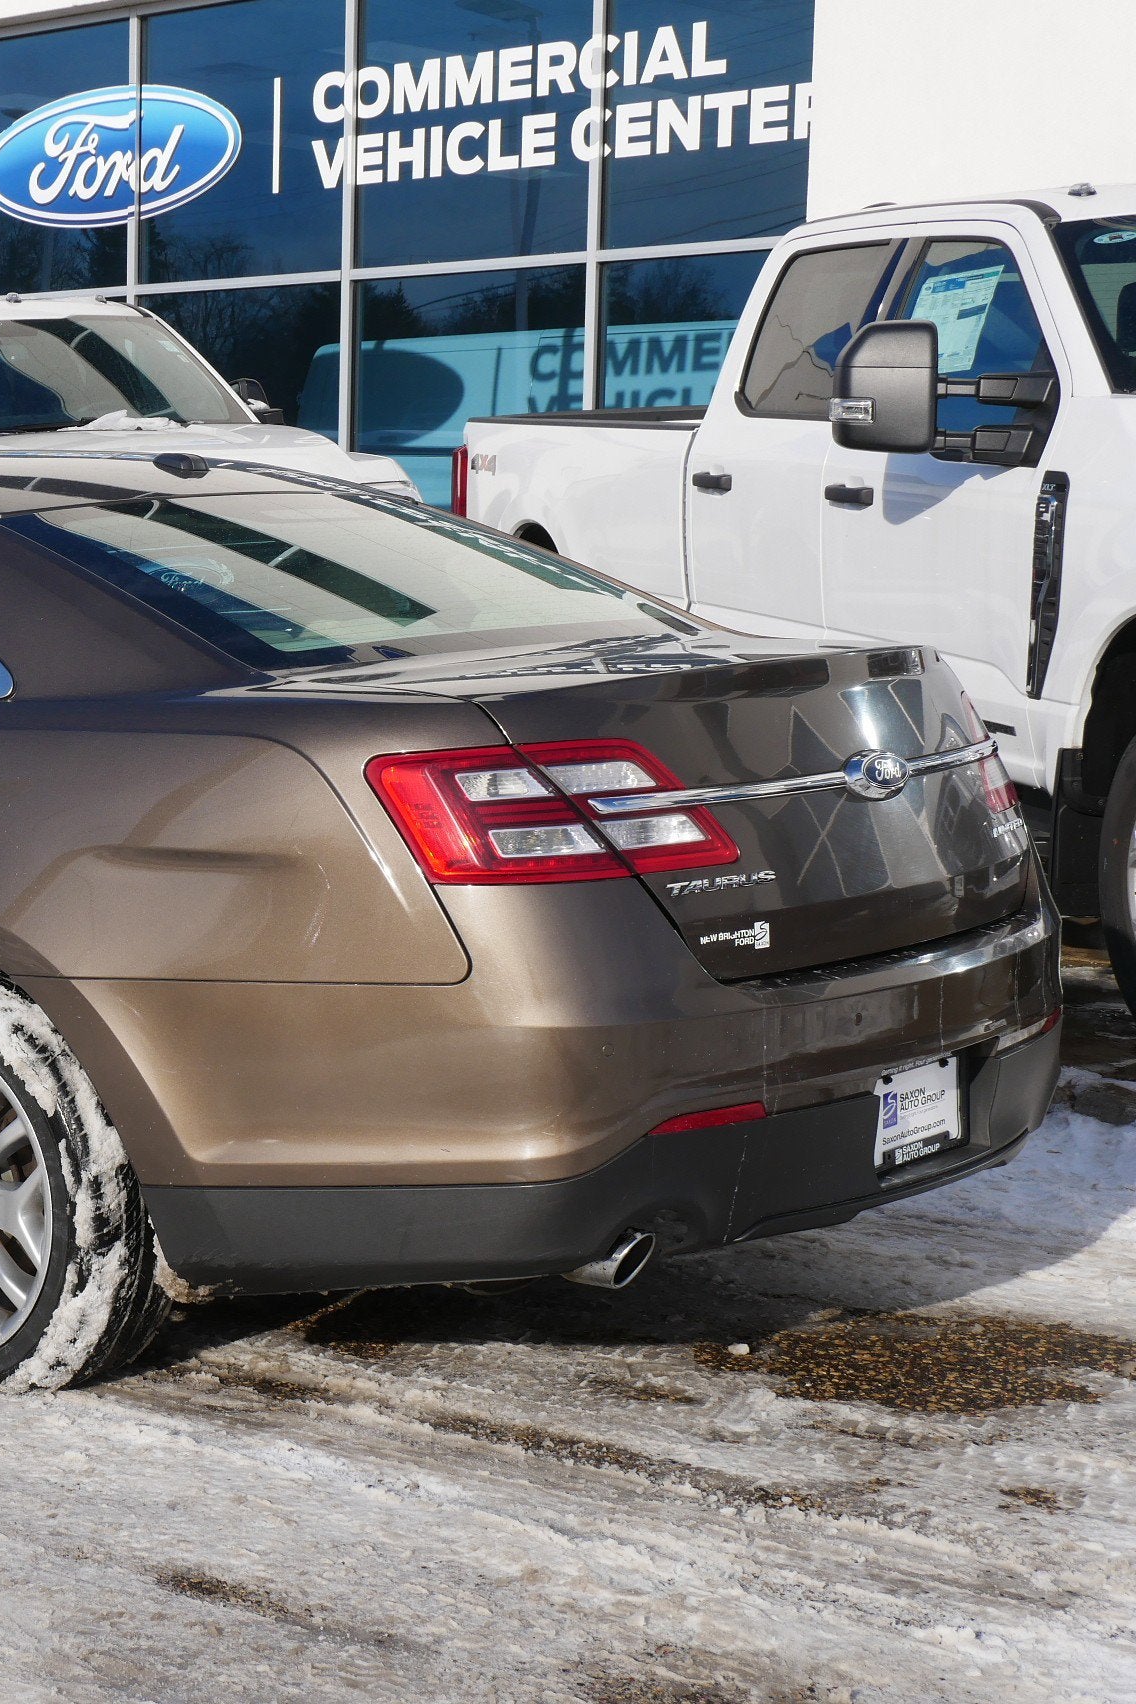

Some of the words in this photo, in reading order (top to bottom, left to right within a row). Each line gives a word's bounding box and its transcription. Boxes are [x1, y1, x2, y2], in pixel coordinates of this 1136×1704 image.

[312, 21, 727, 124] COMMERCIAL
[28, 109, 185, 205] Ford
[311, 112, 557, 190] VEHICLE
[529, 330, 737, 383] COMME
[875, 758, 902, 781] Ford
[665, 870, 777, 898] TAURUS
[700, 932, 718, 945] NEW
[719, 928, 755, 941] BRIGHTON
[735, 937, 755, 947] FORD
[899, 1087, 926, 1103] SAXON
[900, 1098, 920, 1112] AUTO
[921, 1089, 946, 1105] GROUP
[882, 1118, 946, 1146] SaxonAutoGroup.com
[902, 1141, 923, 1153] SAXON
[903, 1149, 919, 1161] AUTO
[920, 1143, 941, 1157] GROUP
